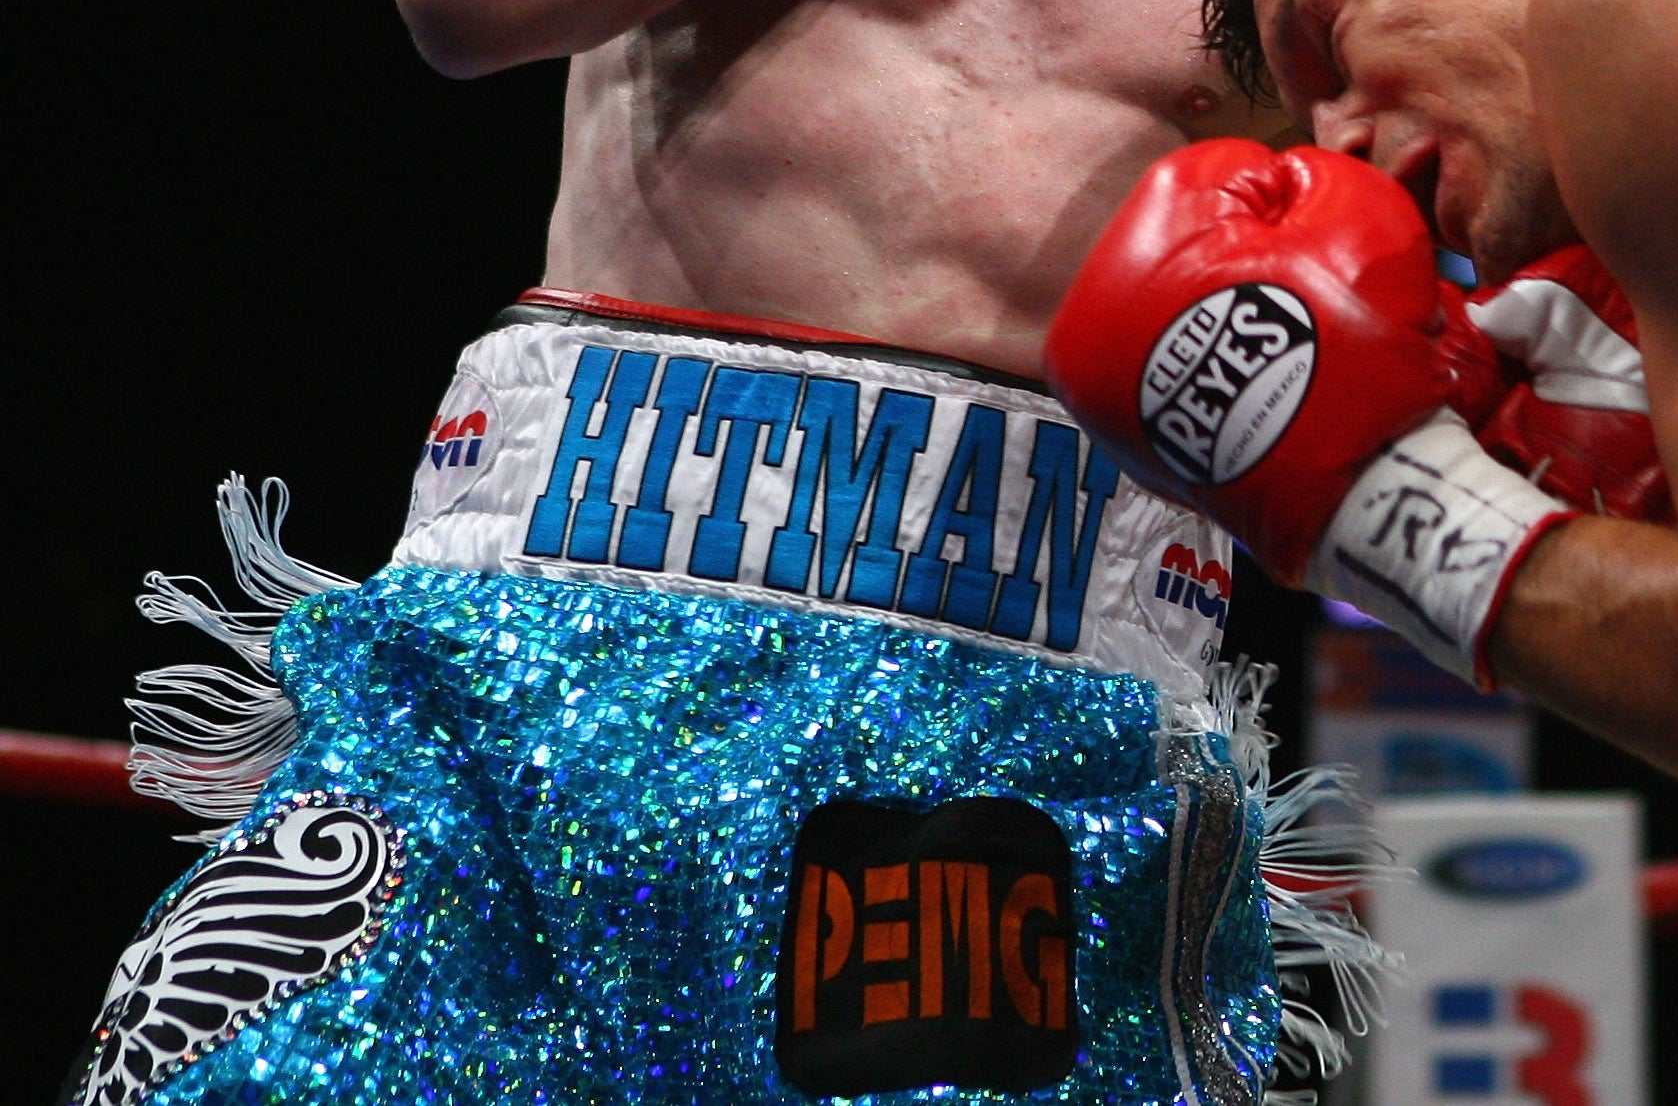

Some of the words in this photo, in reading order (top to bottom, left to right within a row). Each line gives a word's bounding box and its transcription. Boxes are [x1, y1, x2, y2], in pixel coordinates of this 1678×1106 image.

[1147, 306, 1218, 395] CLETO
[1156, 301, 1290, 471] REYES
[521, 343, 1120, 653] HITMAN
[793, 860, 1067, 1033] PEMG
